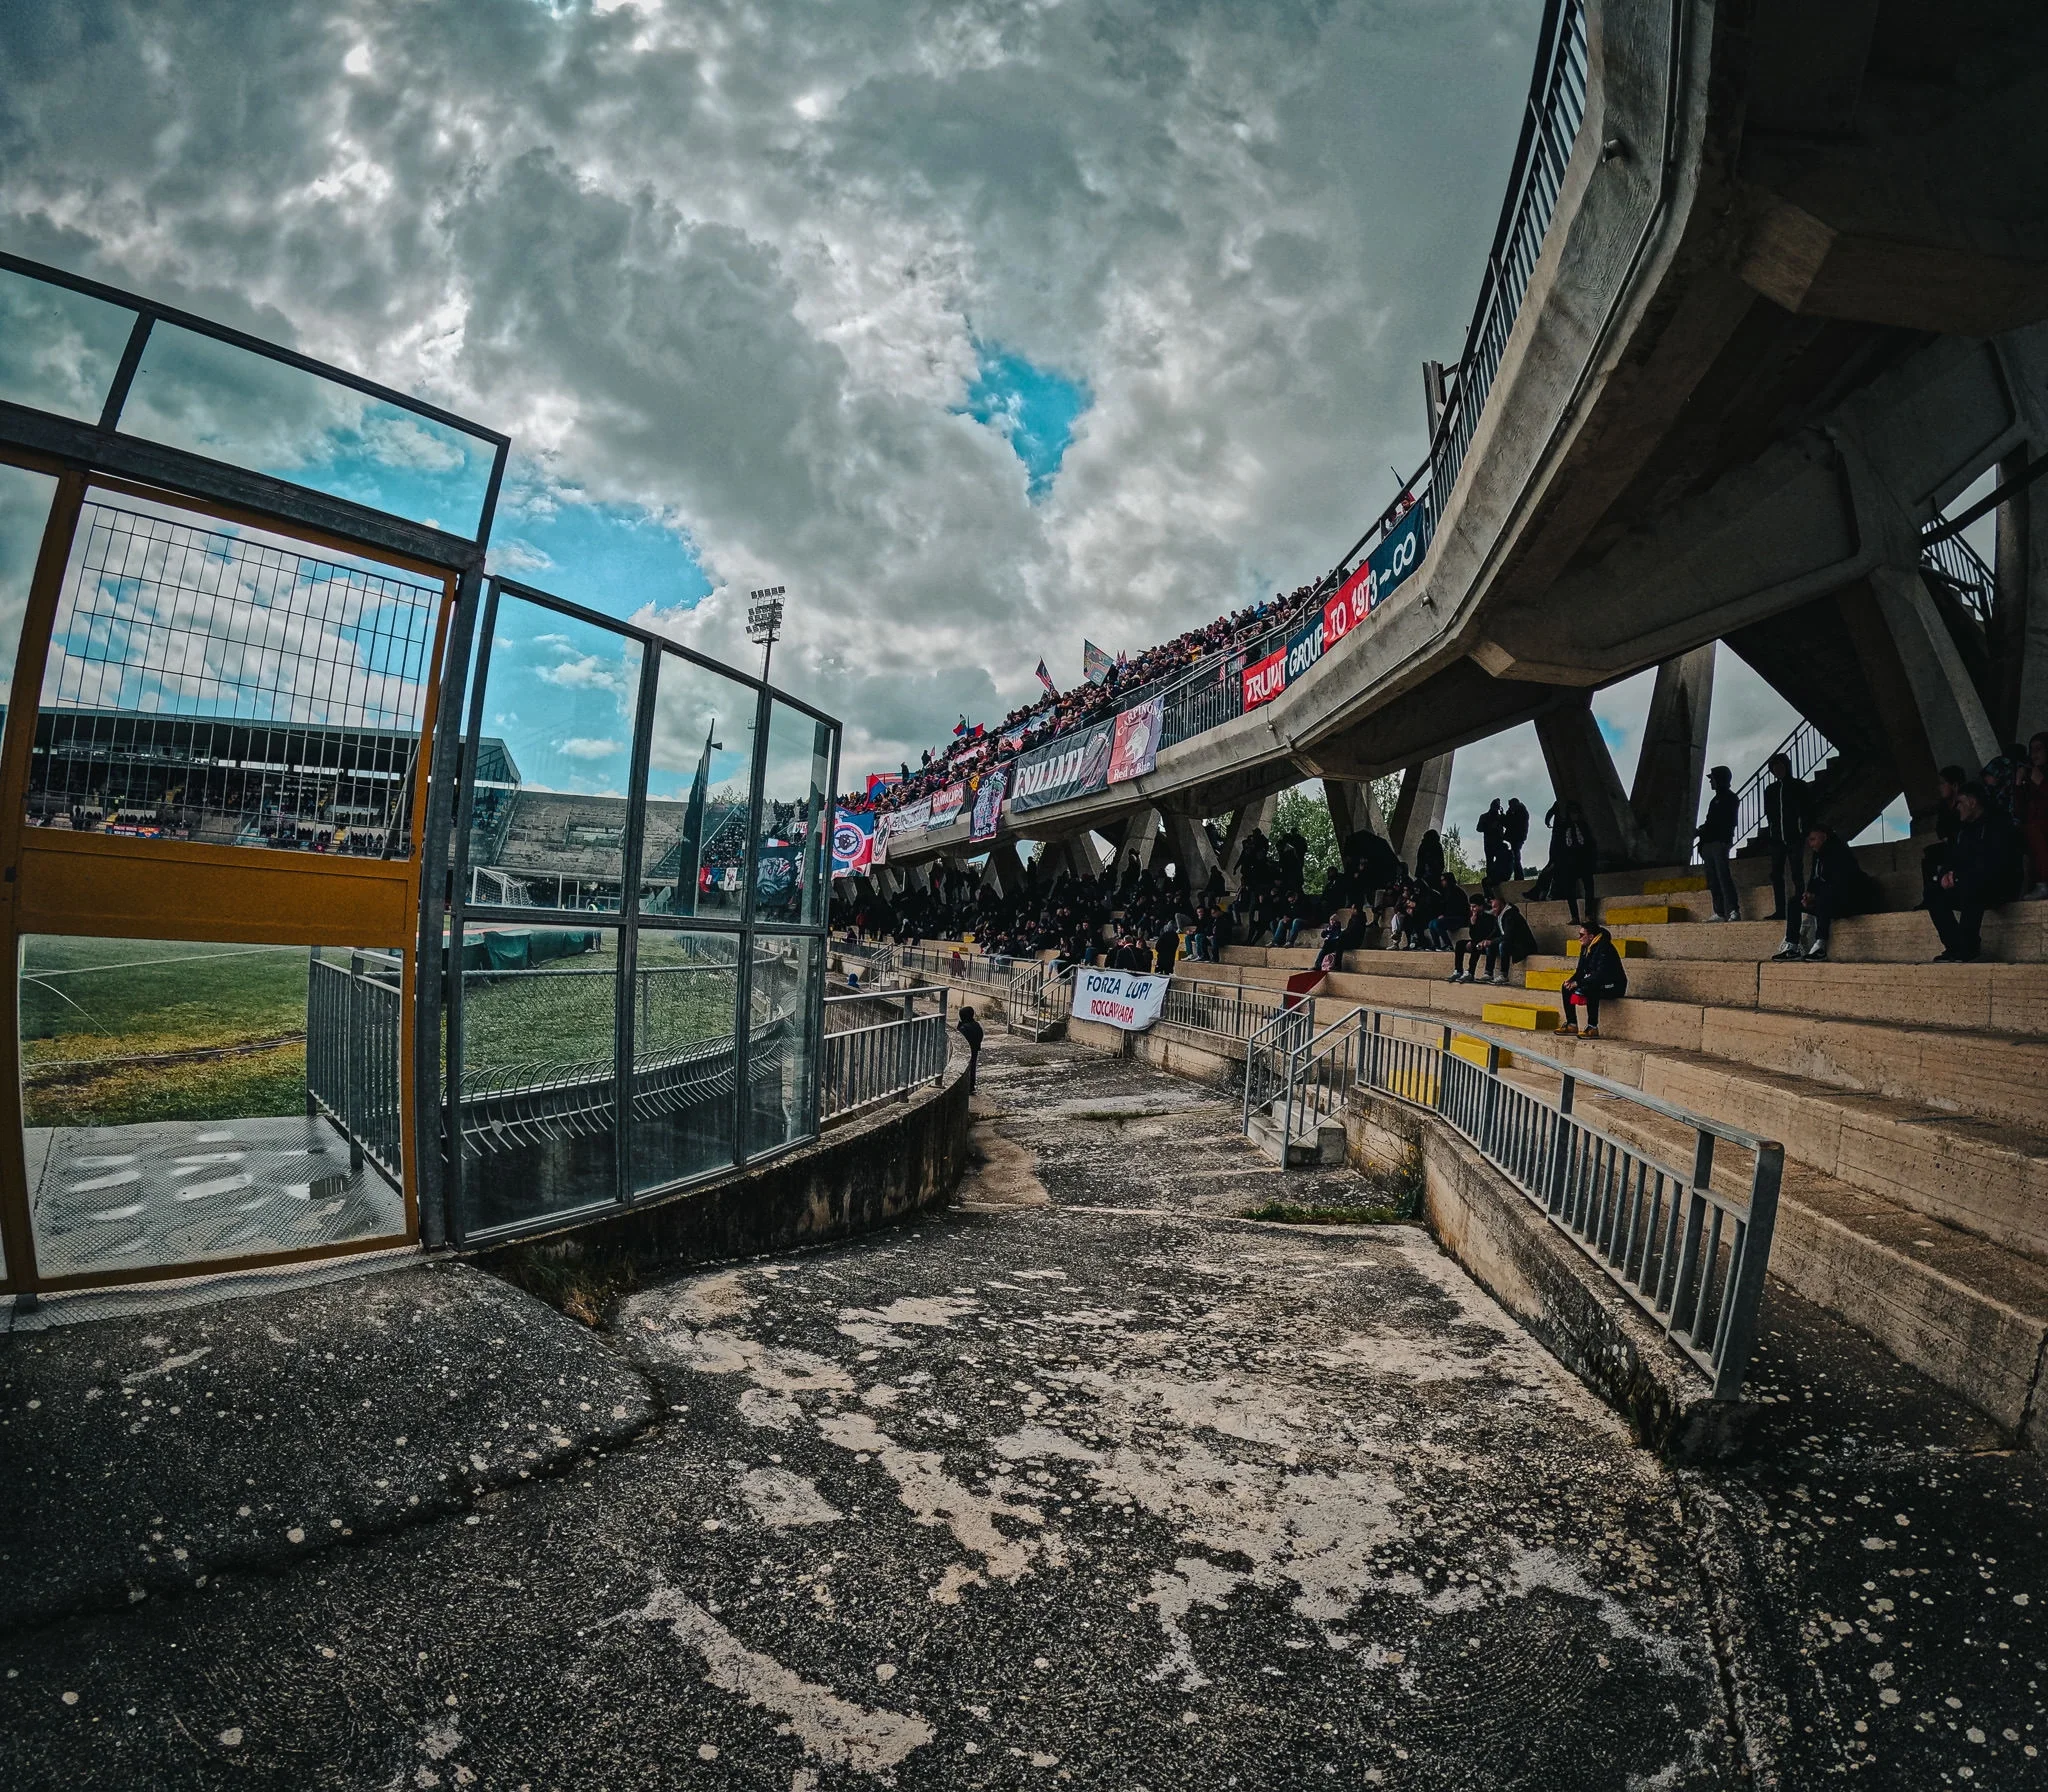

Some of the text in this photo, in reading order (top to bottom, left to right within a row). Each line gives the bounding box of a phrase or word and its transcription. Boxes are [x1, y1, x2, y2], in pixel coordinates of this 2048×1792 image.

[1012, 747, 1085, 799] ESILIATI
[1113, 768, 1128, 780] Red
[1135, 761, 1152, 775] Blue
[1087, 976, 1153, 1000] FORZA LUPI
